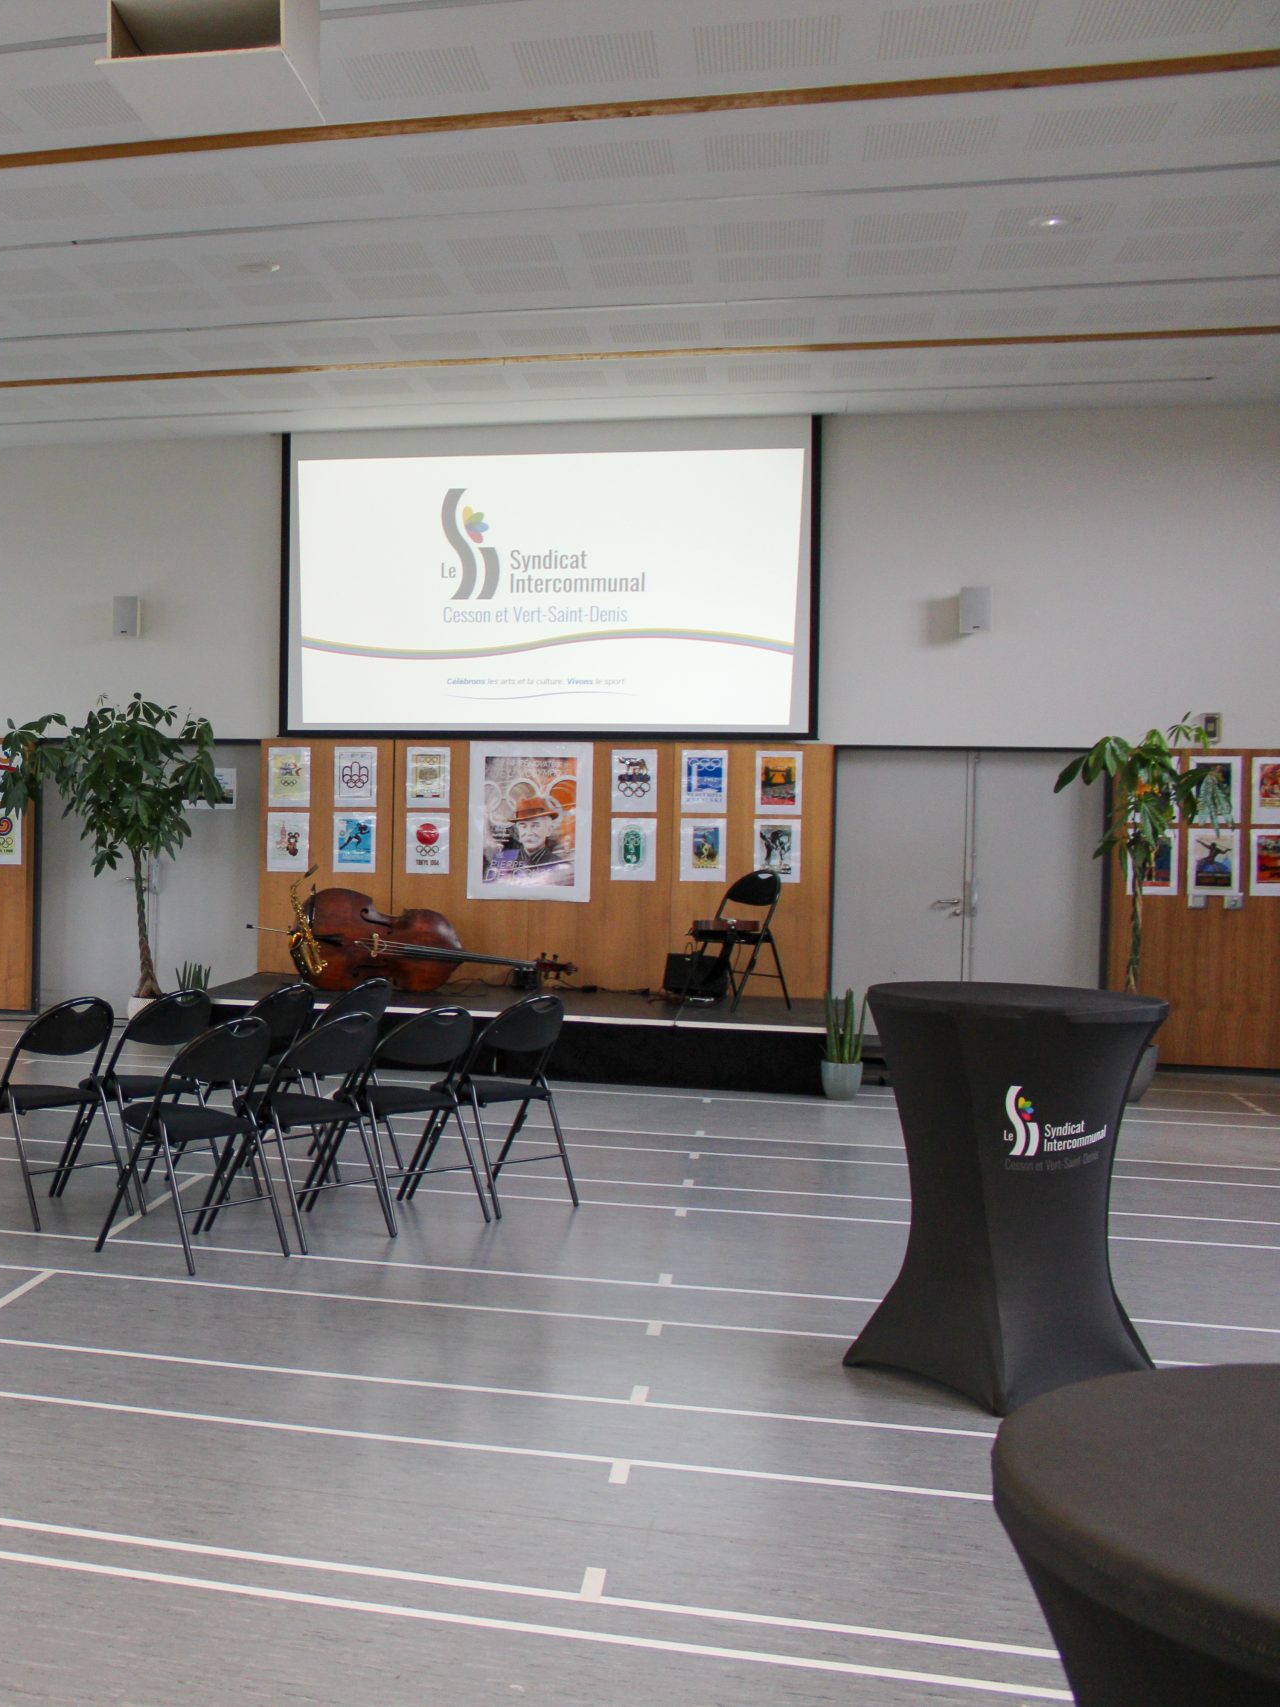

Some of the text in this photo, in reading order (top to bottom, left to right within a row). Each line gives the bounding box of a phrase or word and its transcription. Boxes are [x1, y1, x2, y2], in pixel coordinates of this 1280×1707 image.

[441, 562, 457, 579] Le
[509, 549, 588, 573] Syndicat
[509, 571, 646, 593] Intercommunal
[443, 605, 628, 623] Cesson et Vert-Saint-Denis
[1003, 1129, 1014, 1142] Le
[1043, 1124, 1107, 1152] Intercommunal
[1044, 1120, 1085, 1139] Syndicat
